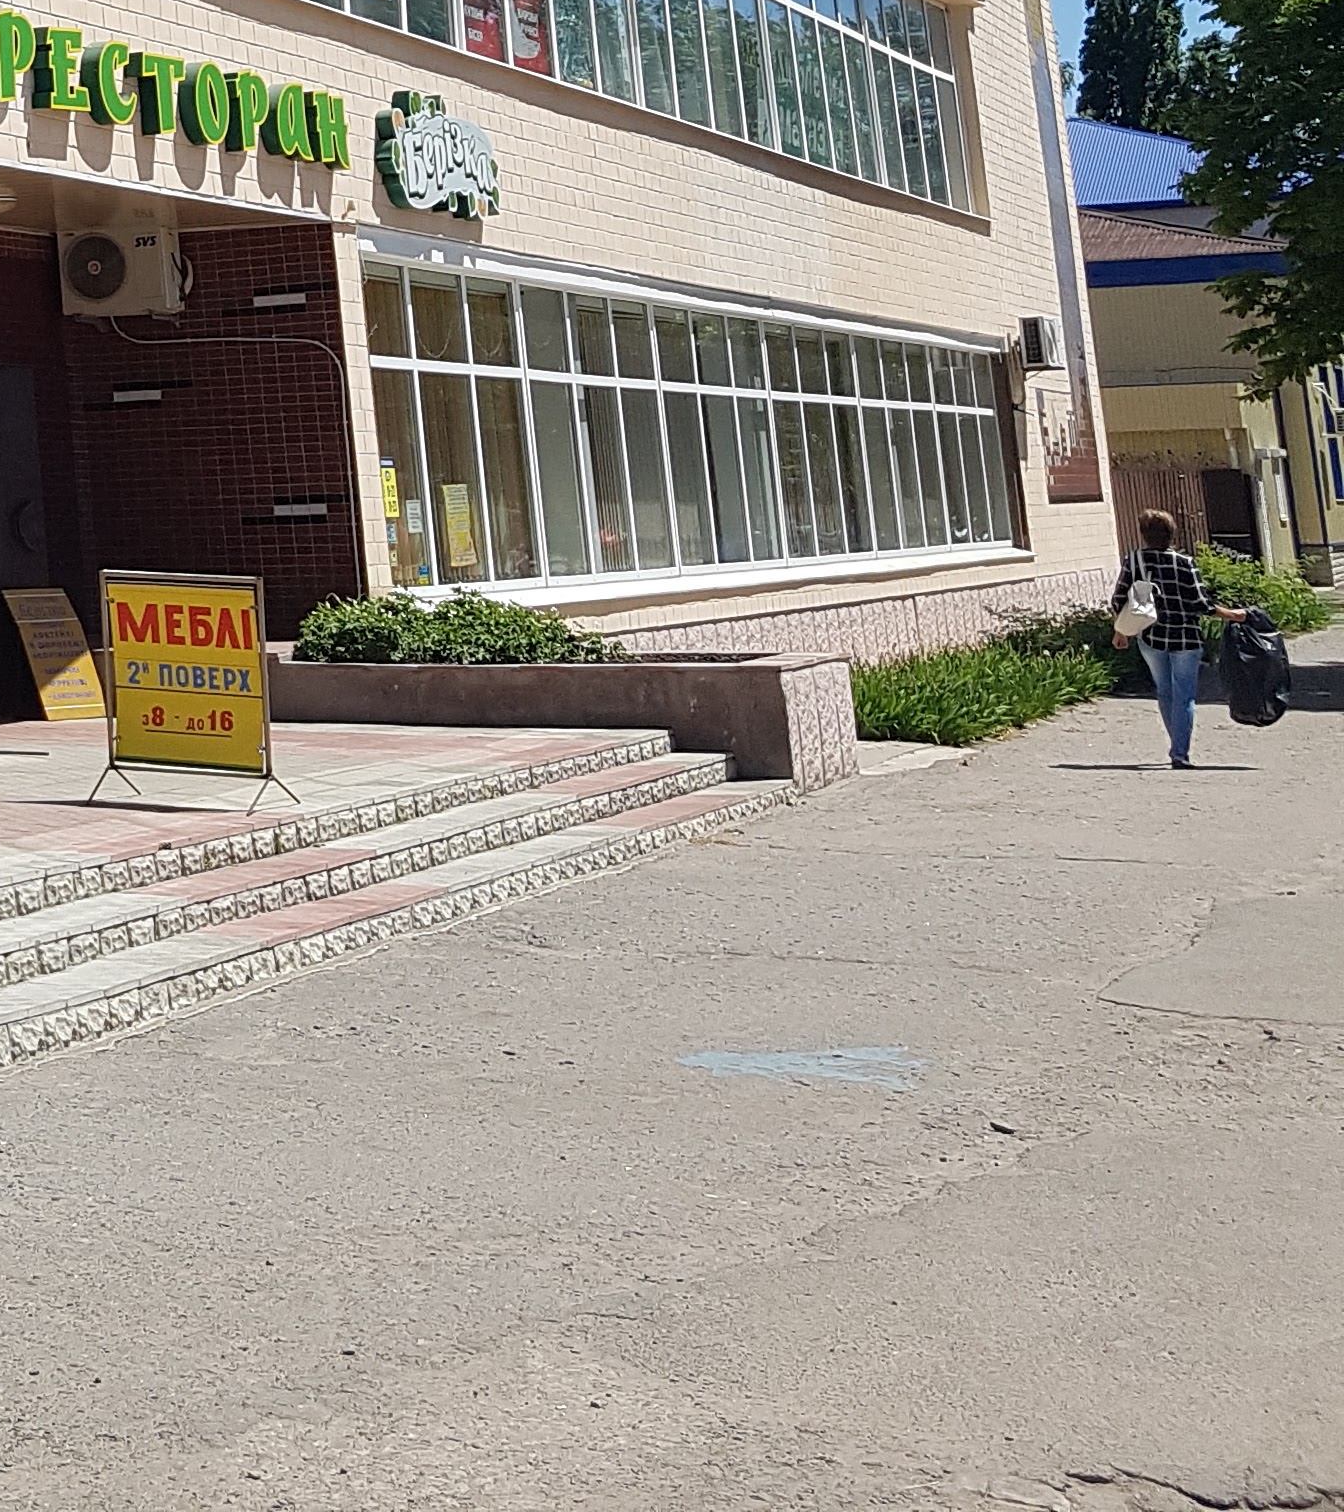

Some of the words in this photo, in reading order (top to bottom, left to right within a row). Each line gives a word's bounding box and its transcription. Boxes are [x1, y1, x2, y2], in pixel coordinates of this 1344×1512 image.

[403, 118, 493, 199] Берізка
[134, 235, 157, 248] SVS
[116, 602, 254, 651] МЕБЛІ
[158, 663, 253, 693] ПОВЕРХ
